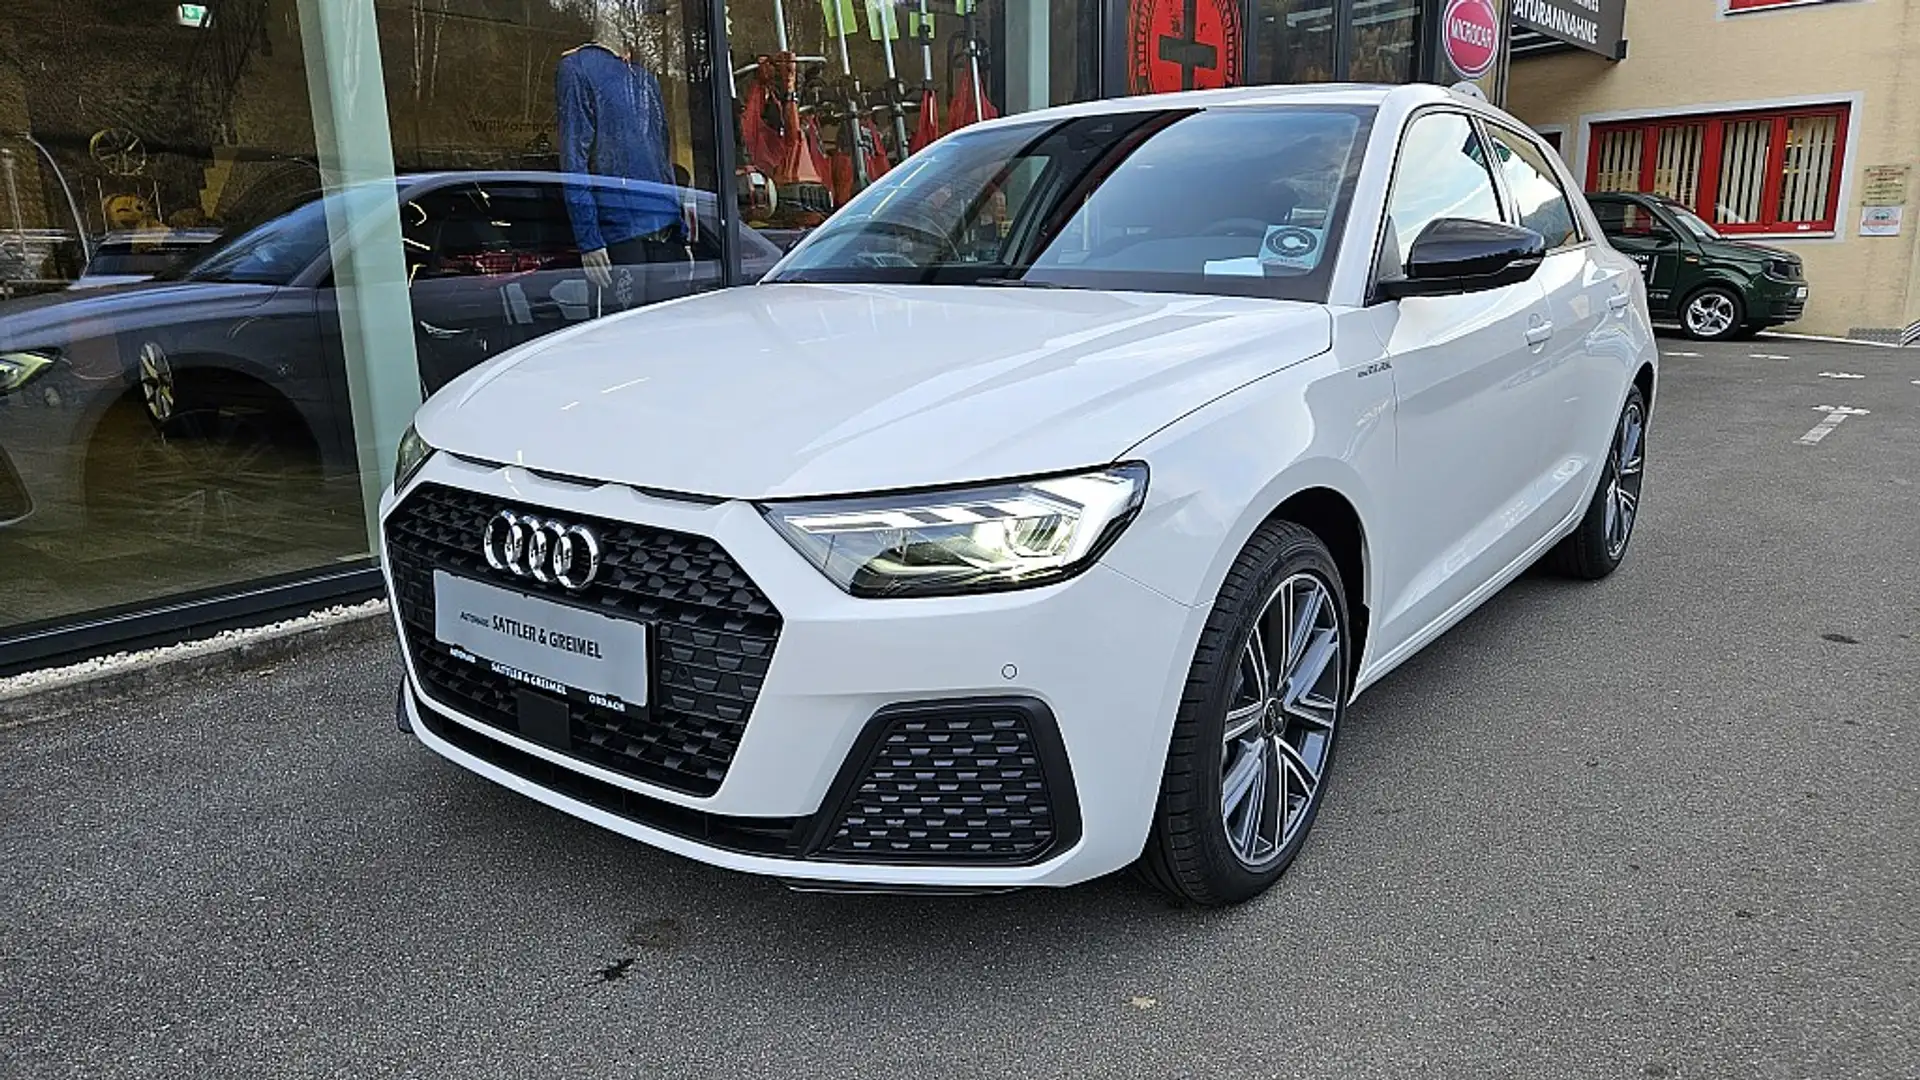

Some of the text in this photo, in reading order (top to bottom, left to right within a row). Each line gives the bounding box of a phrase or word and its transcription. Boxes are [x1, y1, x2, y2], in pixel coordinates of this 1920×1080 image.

[1450, 16, 1492, 49] MICROCAR
[492, 614, 536, 643] SATTLER
[538, 628, 547, 645] &
[549, 631, 603, 660] GREIMEL
[491, 661, 523, 681] SATTLER
